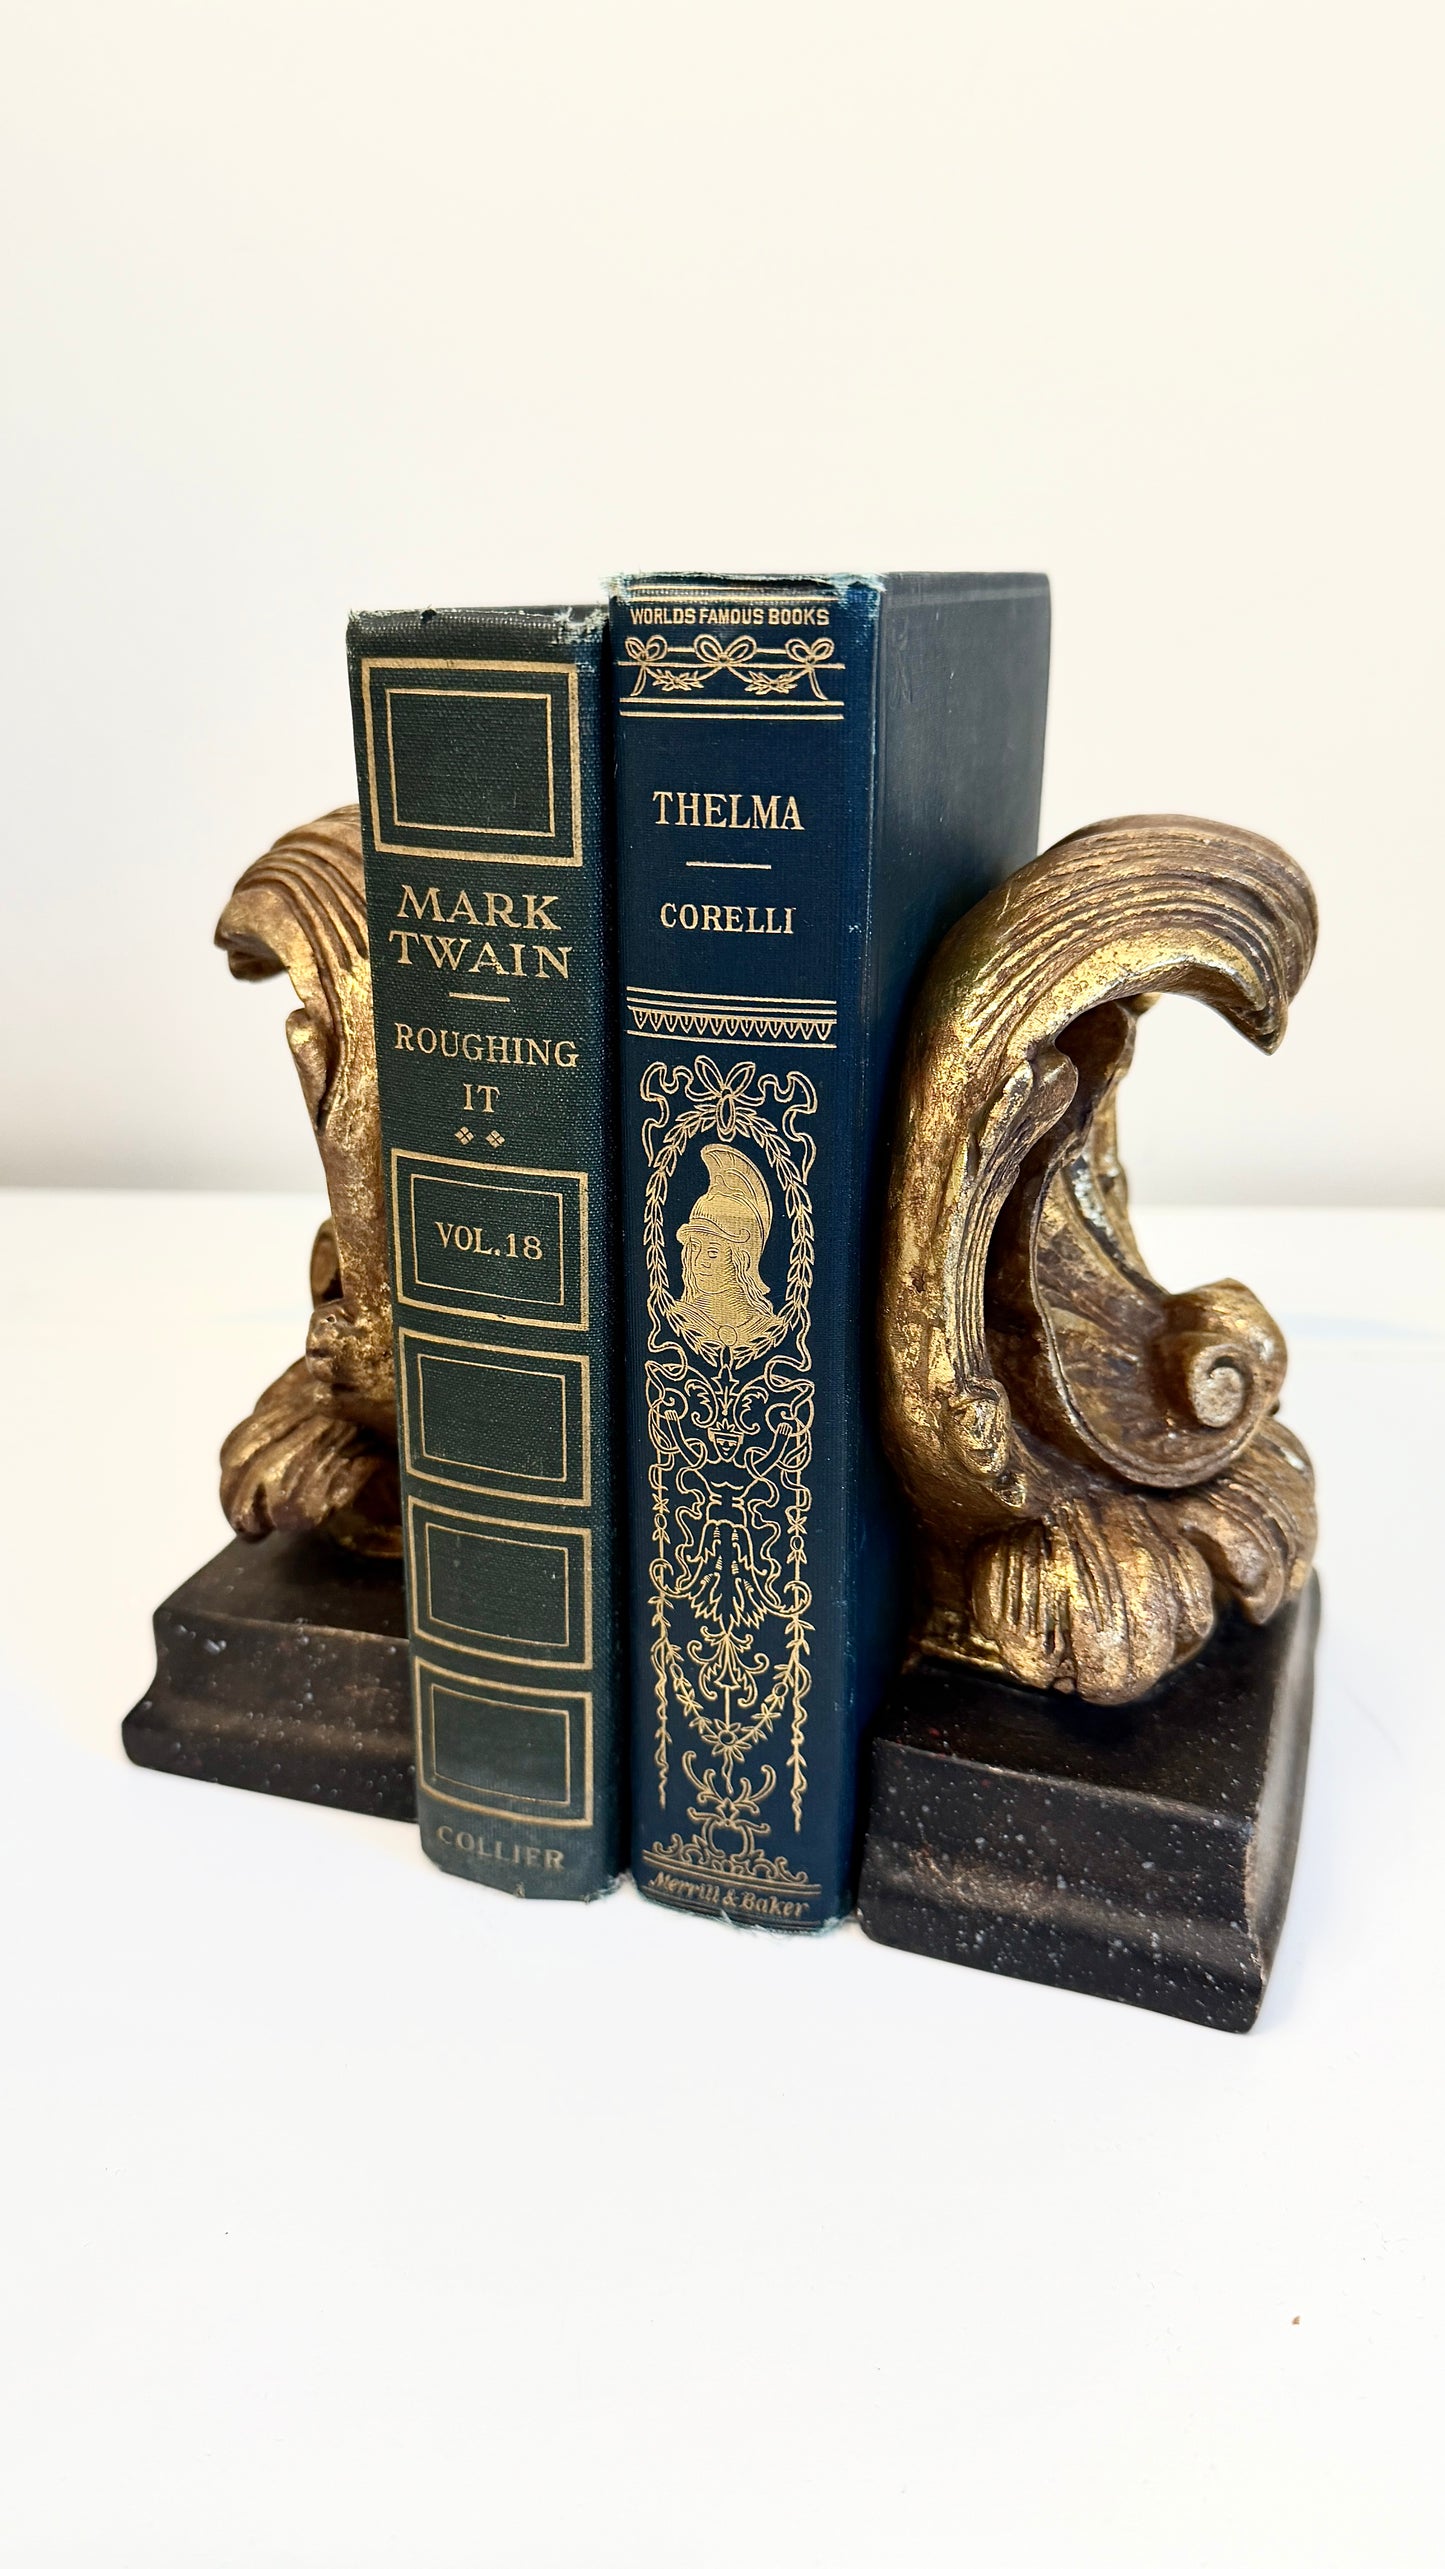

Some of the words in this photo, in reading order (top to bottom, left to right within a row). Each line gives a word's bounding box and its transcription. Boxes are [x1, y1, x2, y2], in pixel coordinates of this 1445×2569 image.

[630, 609, 695, 625] WORLDS
[699, 609, 764, 626] FAMOUS
[768, 610, 829, 626] BOOKS
[652, 791, 805, 831] THELMA
[397, 884, 562, 931] MARK
[660, 903, 796, 935] CORELLI
[389, 930, 573, 979] TWAIN
[394, 1022, 579, 1068] ROUGHING
[463, 1084, 501, 1113] IT
[436, 1825, 566, 1871] COLLIER
[648, 1871, 720, 1905] Merrill
[722, 1888, 740, 1907] &
[740, 1892, 811, 1919] Baker
